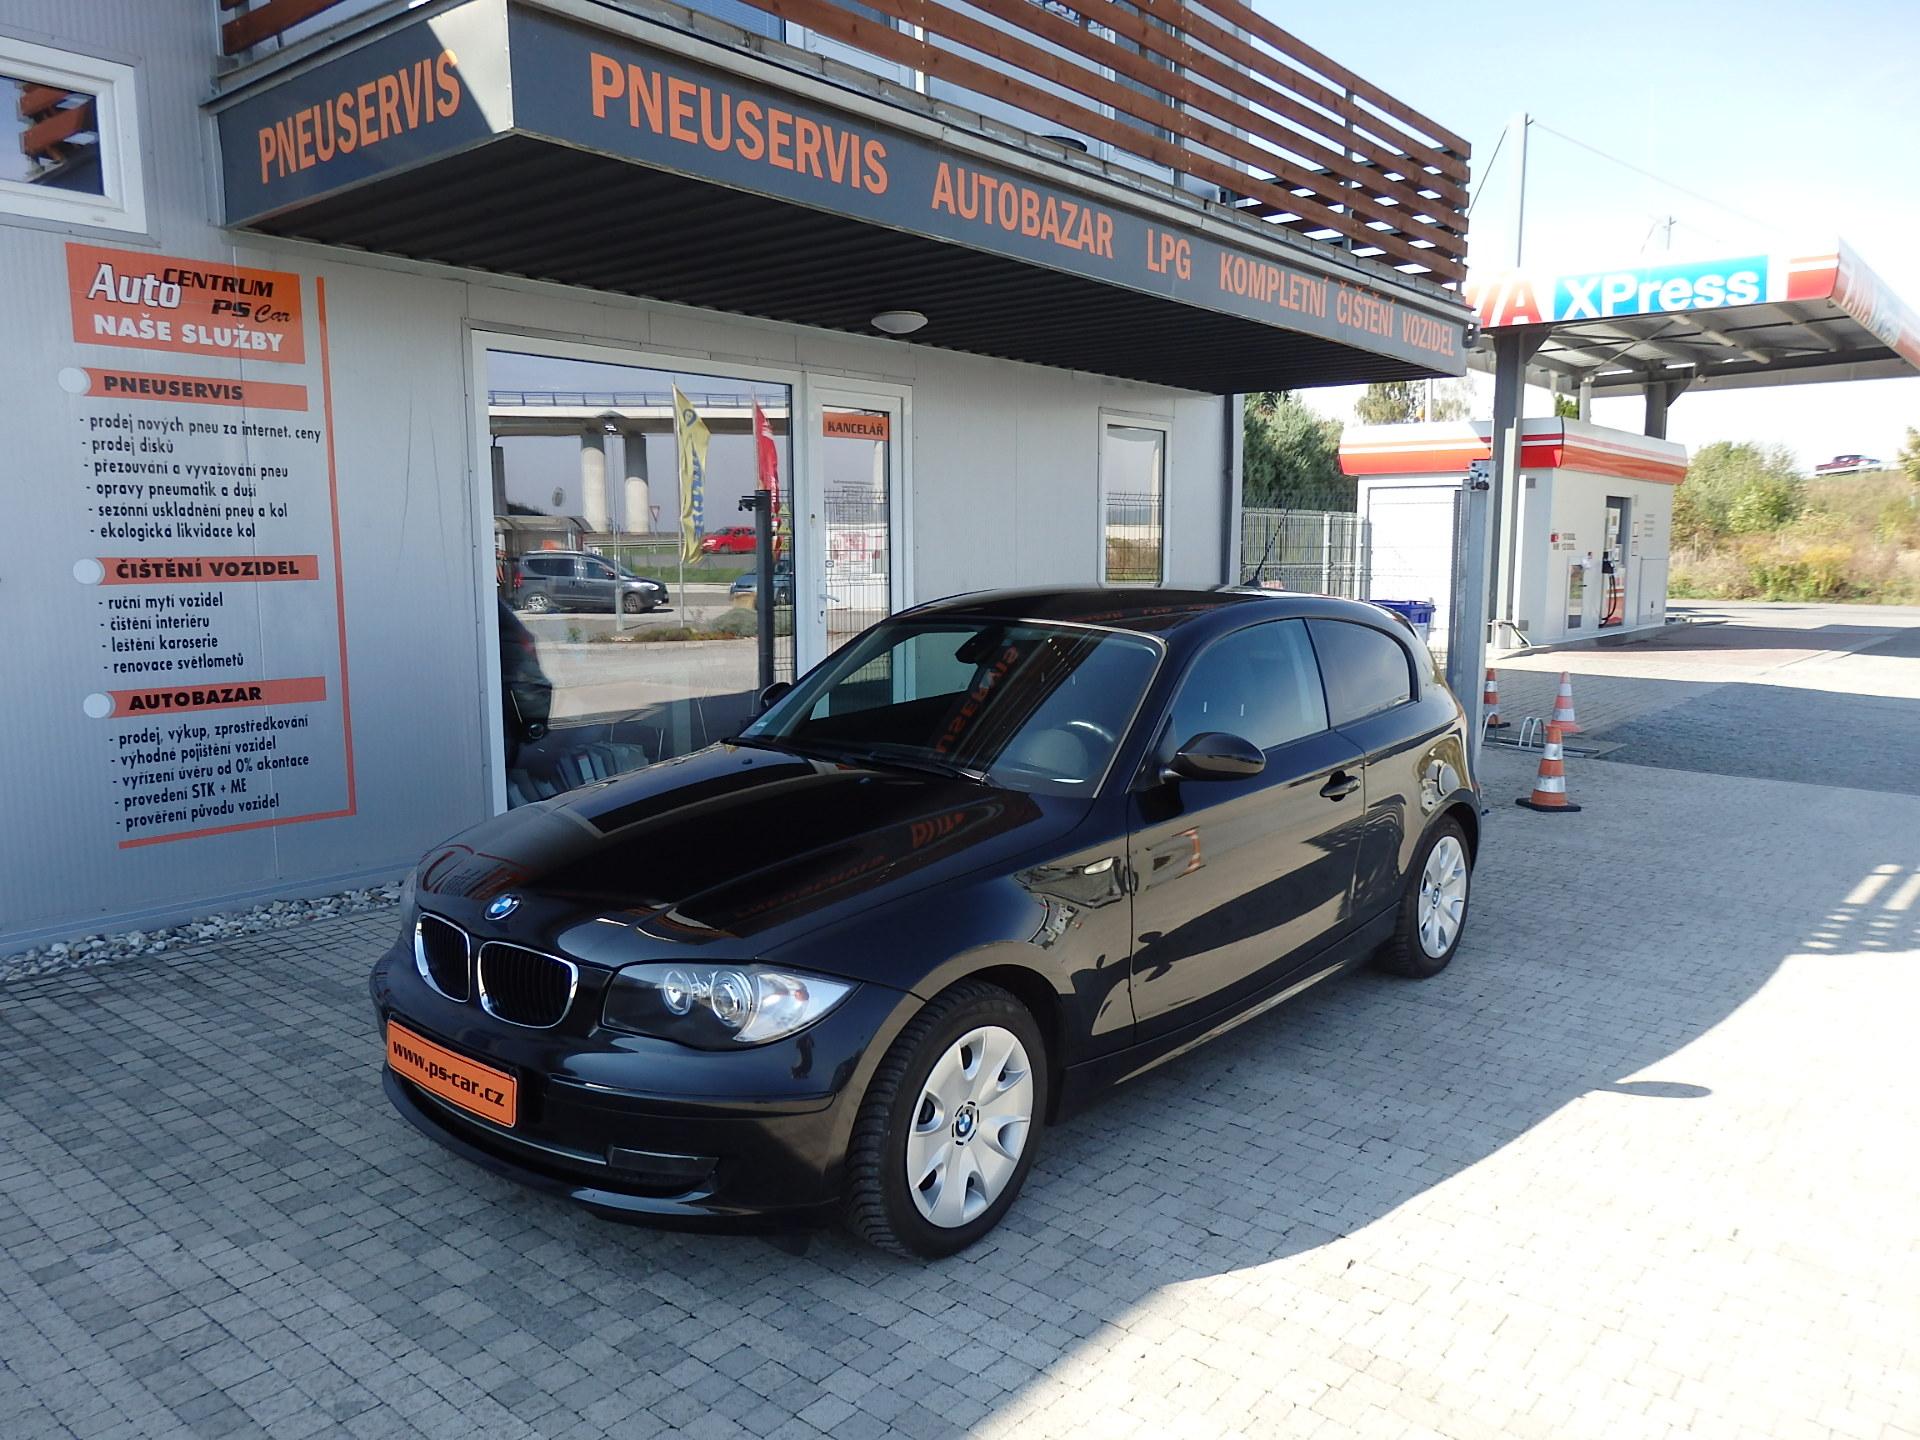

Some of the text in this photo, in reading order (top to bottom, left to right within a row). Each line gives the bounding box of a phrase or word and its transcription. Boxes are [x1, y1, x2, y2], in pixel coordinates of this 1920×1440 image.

[259, 49, 462, 186] PNEUSERVIS
[589, 52, 1456, 357] PNEUSERVIS AUTOBAZAR LPG KOMPLETNÍ ČIŠTĚNÍ VOZIDEL
[87, 263, 274, 309] Auto CENTRUM
[211, 299, 291, 323] PS Car
[94, 313, 284, 352] NAŠE SLUŽBY
[104, 375, 244, 400] PNEUSERVIS
[90, 413, 321, 443] prodej nových pneu za internet. ceny
[827, 420, 884, 437] KANCELÁŘ
[92, 436, 174, 456] prodej disků
[94, 459, 289, 480] přezouvání a vyvažování pneu
[96, 484, 144, 499] opravy
[150, 481, 215, 499] pneumatik
[221, 486, 229, 497] a
[98, 502, 288, 521] sezónní uskladnění pneu a kol
[100, 522, 256, 541] ekologická likvidace kol
[116, 558, 300, 579] ČIŠTĚNÍ VOZIDEL
[108, 594, 142, 610] ruční
[178, 592, 224, 608] vozidel
[110, 615, 210, 632] čištění interiéru
[111, 633, 219, 653] leštění karoserie
[113, 653, 244, 675] renovace světlometů
[128, 686, 263, 711] AUTOBAZAR
[168, 724, 210, 744] výkup,
[214, 716, 309, 737] zprostředkování
[120, 736, 278, 770] výhodné pojištění vozidel
[122, 755, 311, 790] vyřízení úvěru od 0% akontace
[124, 787, 189, 812] provedení
[191, 783, 217, 799] STK
[230, 777, 248, 794] ME
[125, 793, 281, 833] prověření původu vozidel
[393, 1041, 505, 1107] www.ps-car.cz
